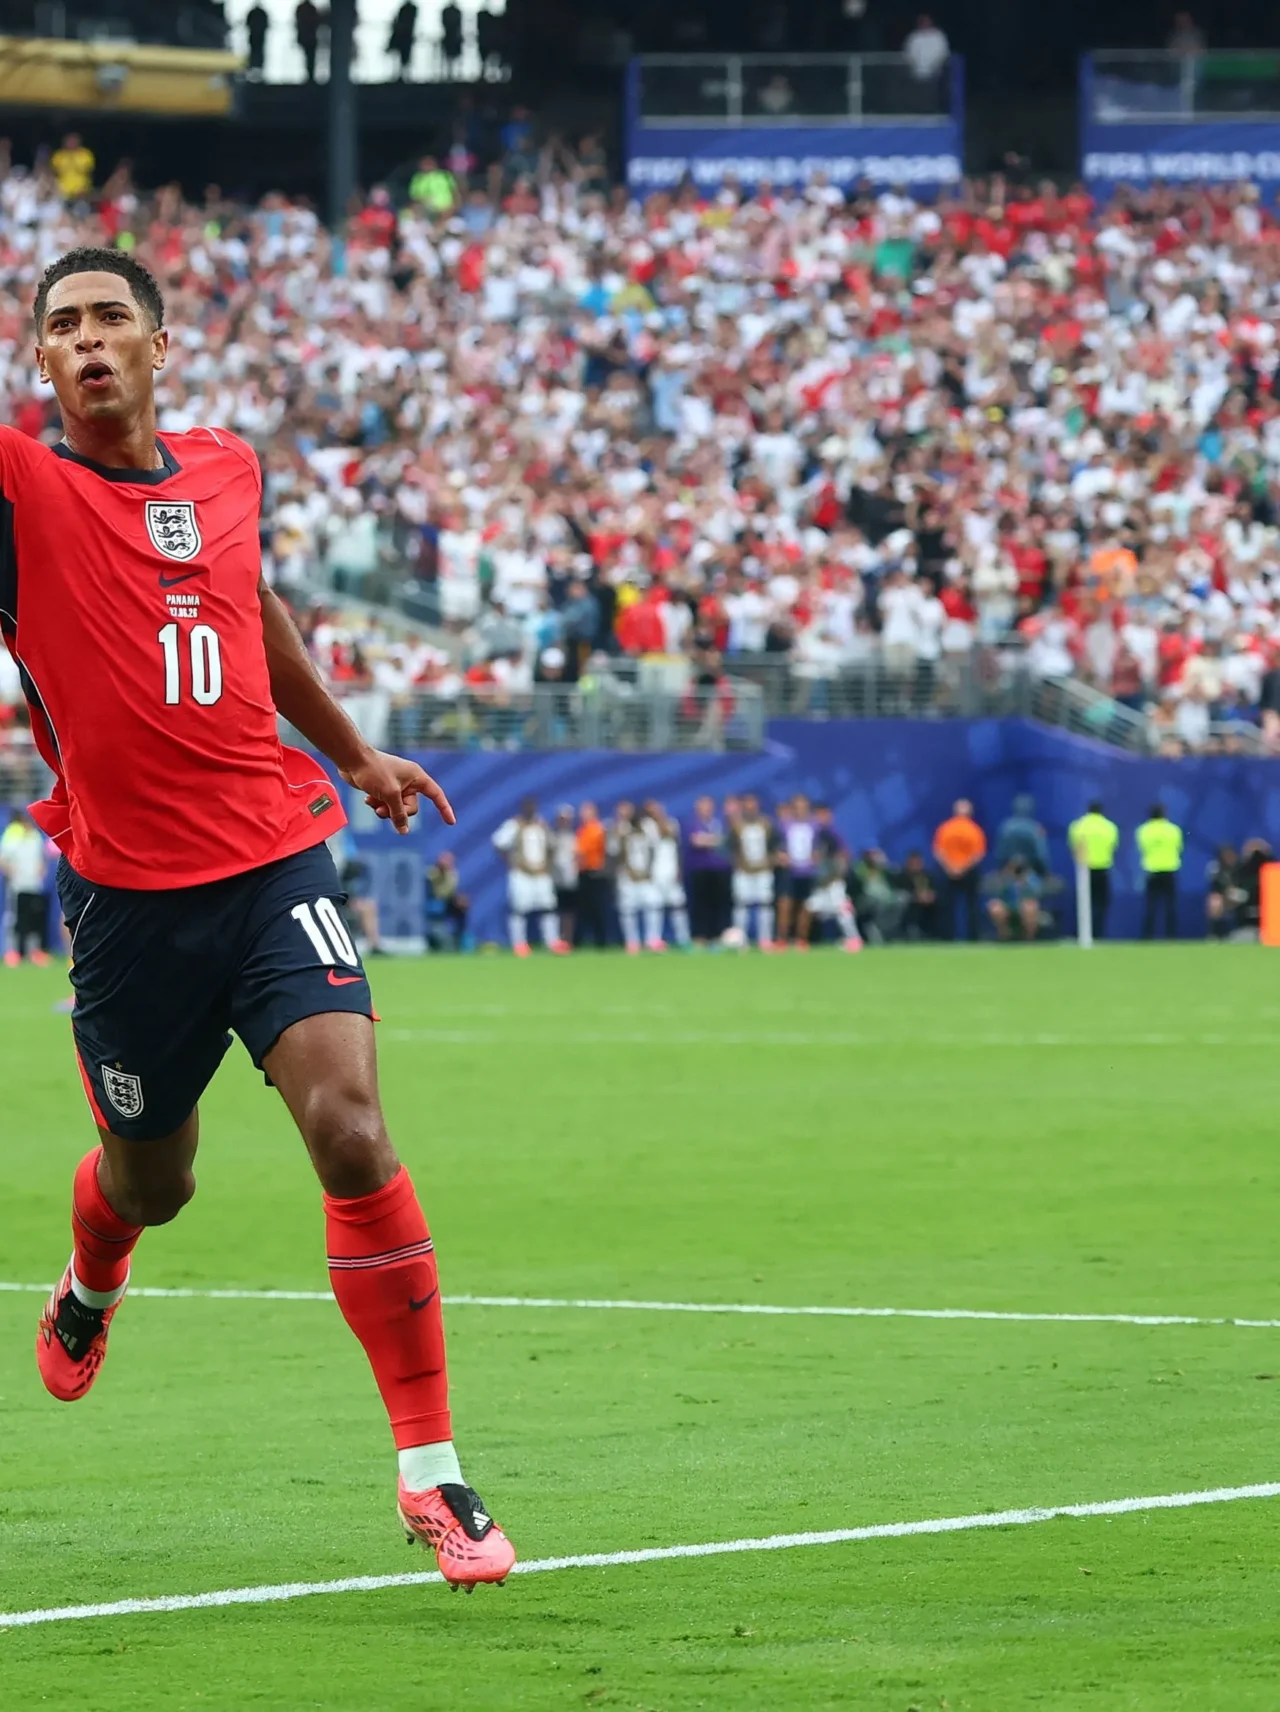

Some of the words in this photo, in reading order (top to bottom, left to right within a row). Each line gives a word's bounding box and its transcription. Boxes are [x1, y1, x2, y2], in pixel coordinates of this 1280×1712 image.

[165, 594, 200, 606] PANAMA
[158, 623, 222, 705] 10
[290, 896, 358, 968] 10
